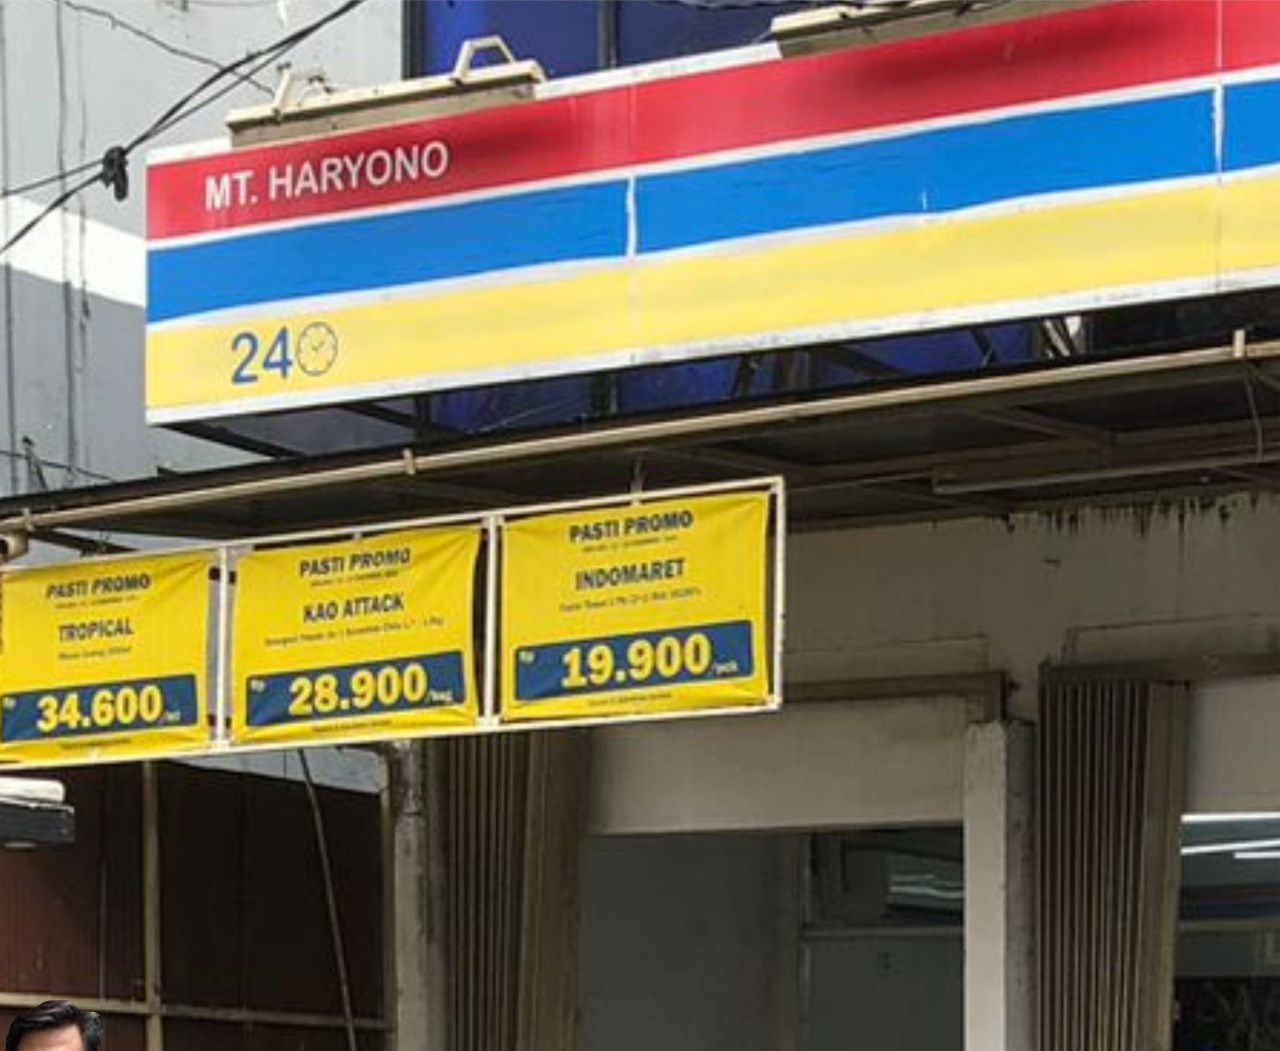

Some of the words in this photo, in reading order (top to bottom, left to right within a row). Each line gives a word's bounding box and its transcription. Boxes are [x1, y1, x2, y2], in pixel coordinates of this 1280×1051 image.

[205, 172, 258, 211] MT.
[269, 140, 449, 199] HARYONO
[231, 327, 293, 384] 24
[570, 519, 619, 543] PASTI
[624, 510, 693, 535] PROMO
[300, 556, 344, 577] PASTI
[350, 548, 411, 570] PROMO
[576, 557, 685, 590] INDOMARET
[46, 580, 89, 598] PASTI
[91, 573, 151, 594] PROMO
[303, 602, 338, 623] KAO
[343, 592, 405, 618] ATTACK
[58, 617, 135, 642] TROPICAL
[562, 632, 712, 688] 19.900
[288, 662, 427, 716] 28.900
[36, 684, 163, 732] 34.600
